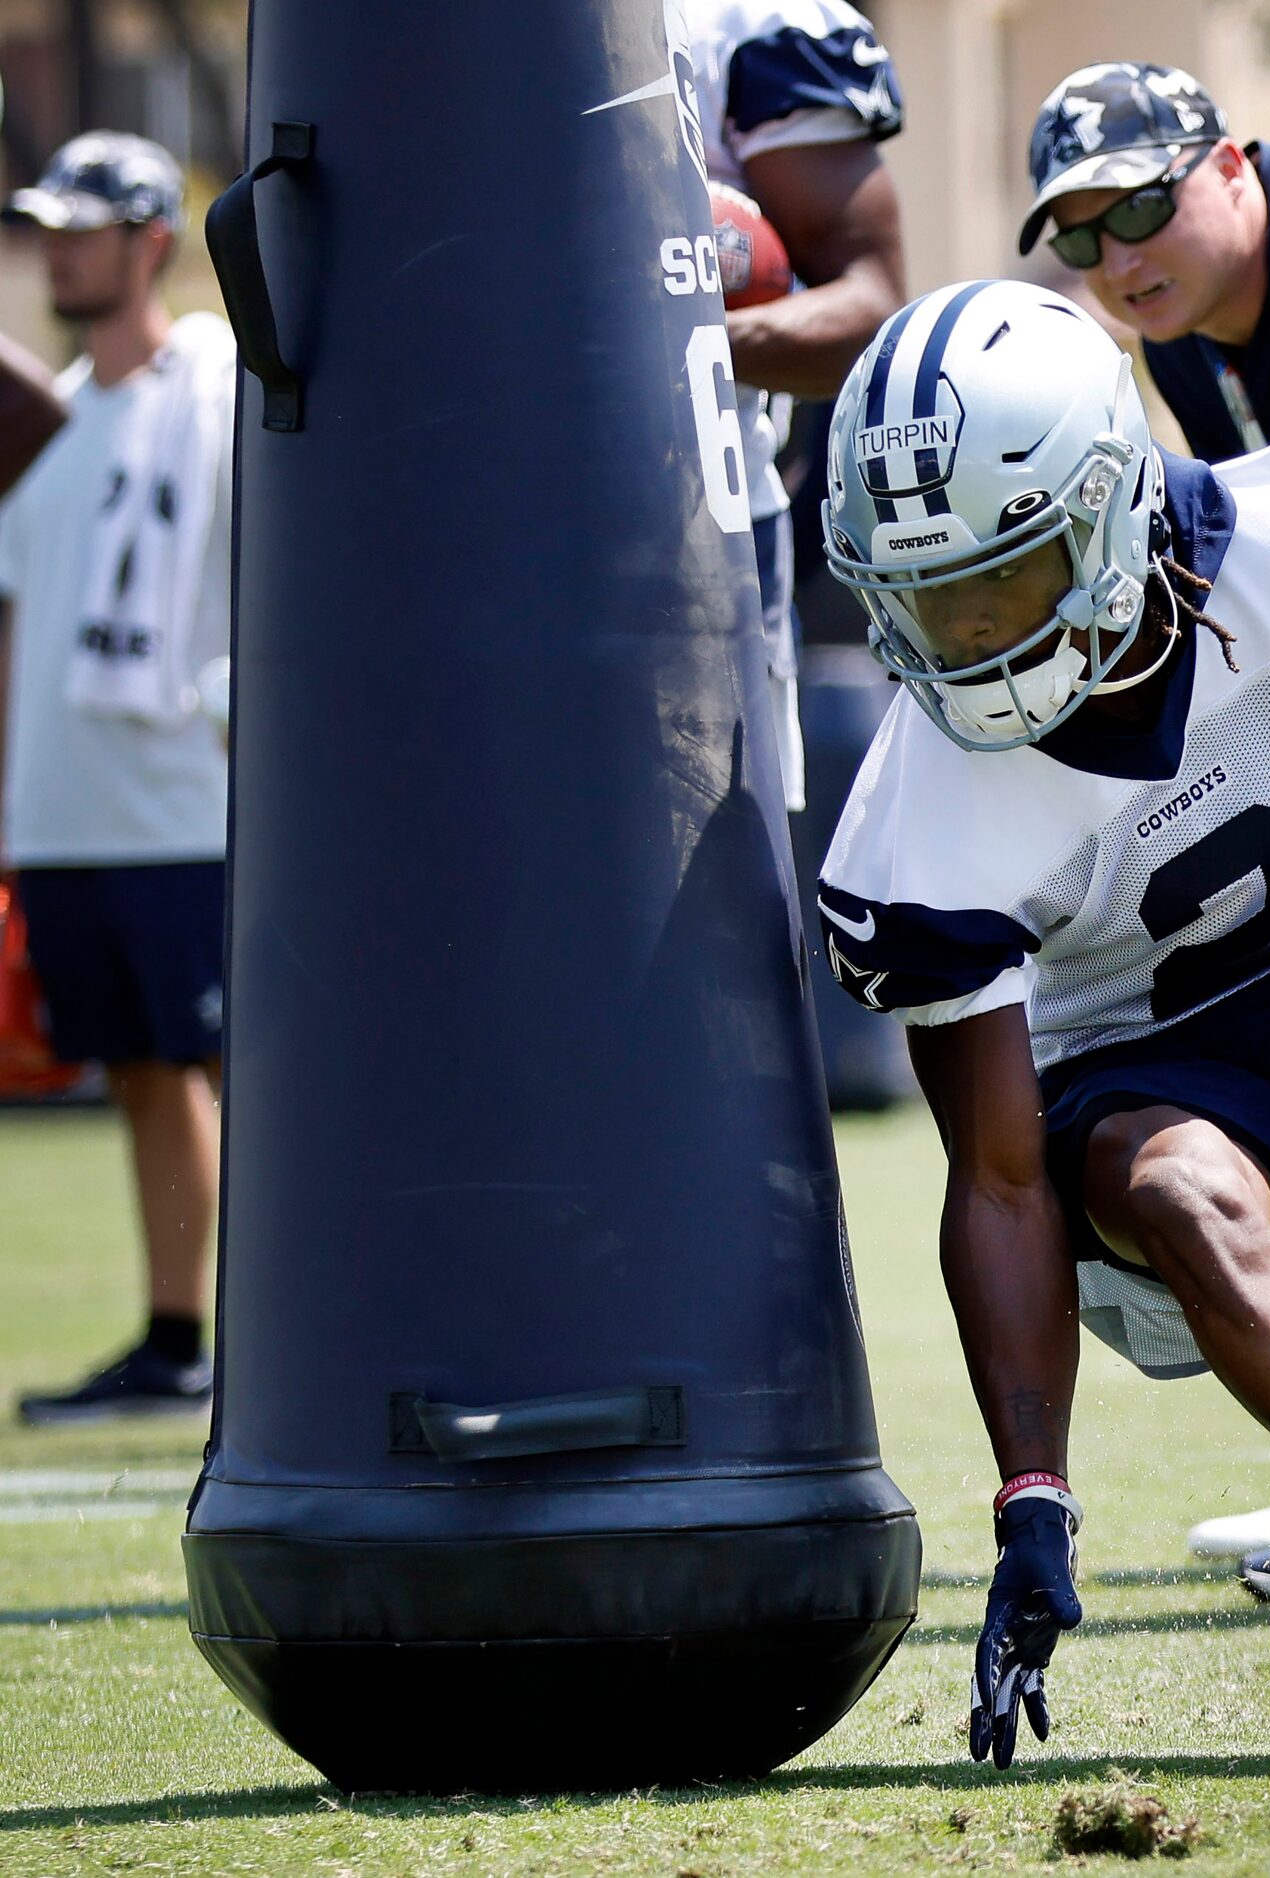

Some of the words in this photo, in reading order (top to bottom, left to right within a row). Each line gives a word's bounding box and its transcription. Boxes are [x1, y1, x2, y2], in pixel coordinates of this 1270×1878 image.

[686, 324, 751, 534] 6
[859, 421, 948, 455] TURPIN
[888, 532, 950, 550] COWBOYS
[1136, 765, 1227, 839] COWBOYS
